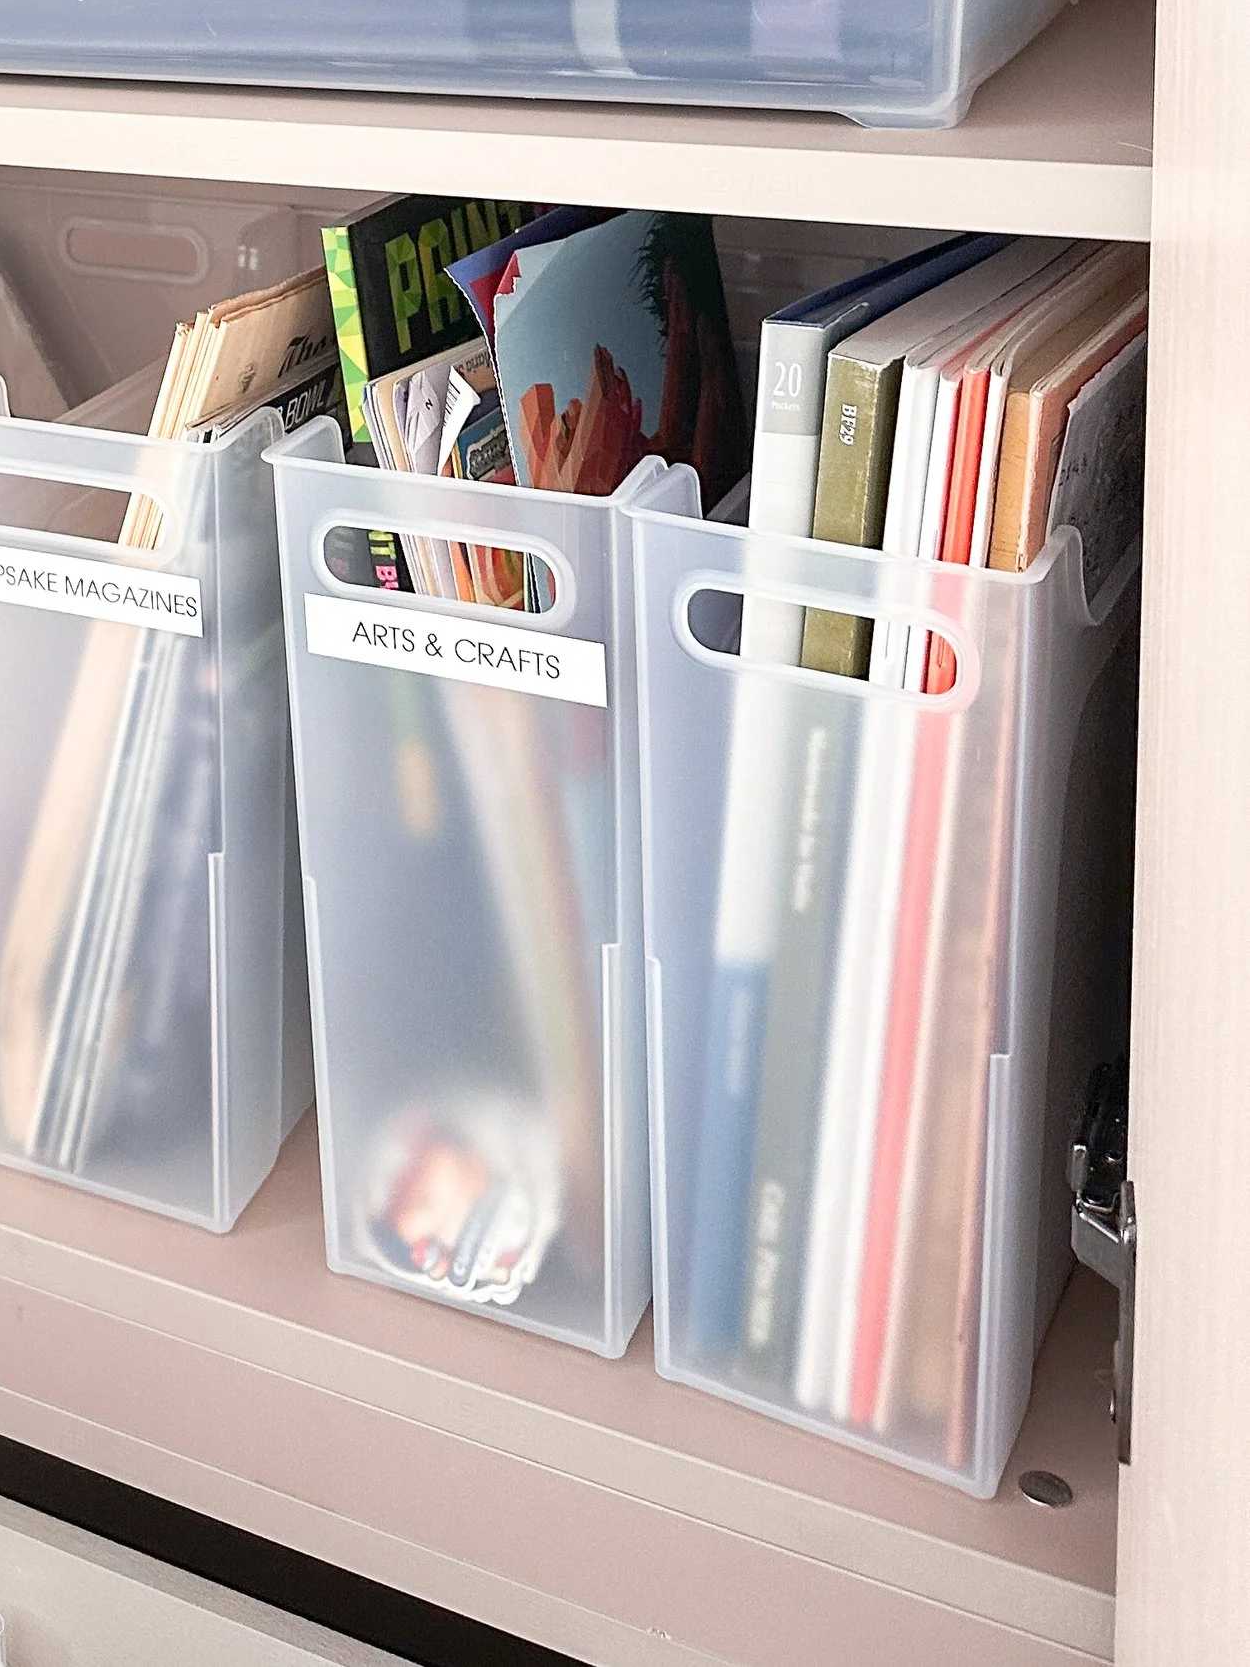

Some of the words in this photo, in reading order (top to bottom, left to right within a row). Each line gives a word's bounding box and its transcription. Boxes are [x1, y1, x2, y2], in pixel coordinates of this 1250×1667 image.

[772, 361, 802, 398] 20
[285, 379, 327, 429] BOWL
[771, 400, 800, 411] Pockets
[838, 403, 858, 446] BF29
[65, 575, 198, 619] MAGAZINES
[351, 621, 415, 654] ARTS
[424, 632, 445, 659] &
[454, 638, 562, 681] CRAFTS
